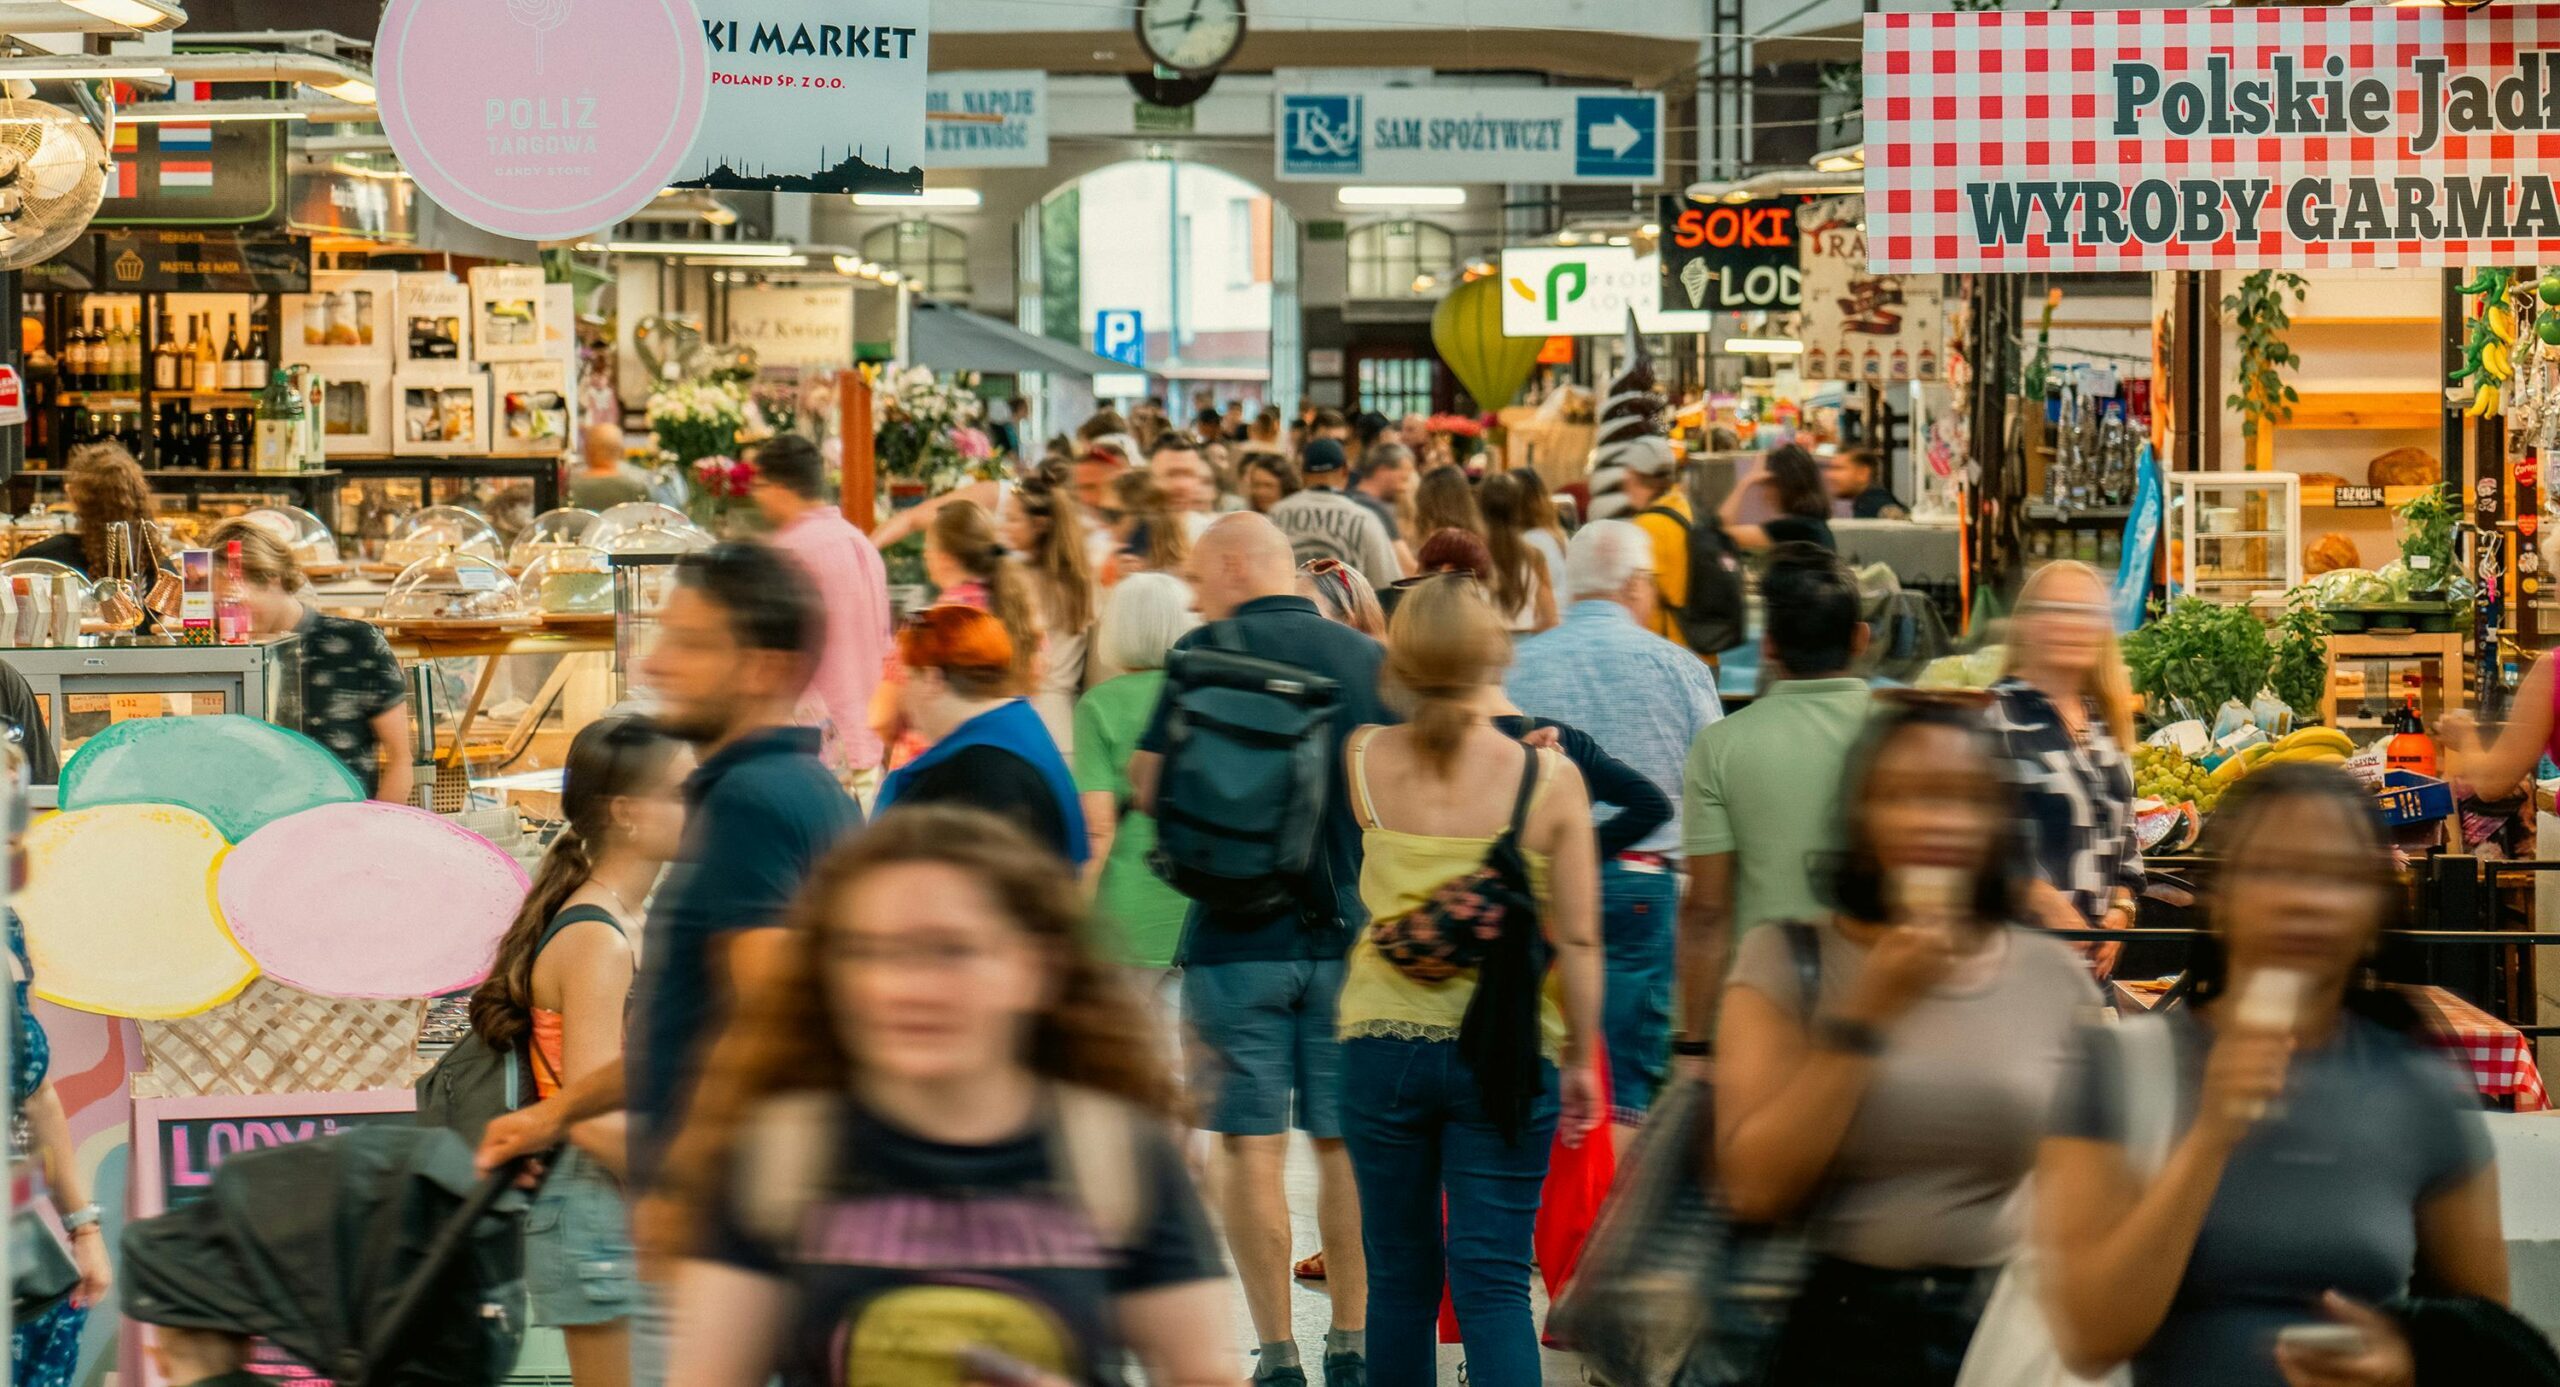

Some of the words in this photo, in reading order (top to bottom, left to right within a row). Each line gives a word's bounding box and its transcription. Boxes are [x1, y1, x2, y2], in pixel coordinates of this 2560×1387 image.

[750, 22, 916, 59] MARKET
[963, 90, 1035, 114] NAPOJE
[2112, 54, 2391, 136] Polskie
[486, 135, 598, 154] TARGOWA
[1374, 118, 1421, 149] SAM
[1428, 113, 1564, 151] SPOŻYWCZY
[495, 165, 543, 176] CANDY
[546, 166, 593, 176] STORE
[1674, 207, 1792, 249] SOKI
[1967, 178, 2270, 246] WYROBY
[2286, 176, 2560, 242] GARMA
[159, 261, 195, 274] PASTEL
[197, 261, 213, 274] DE
[214, 261, 241, 274] NATA
[1720, 264, 1802, 307] LOD
[1104, 313, 1136, 355] P
